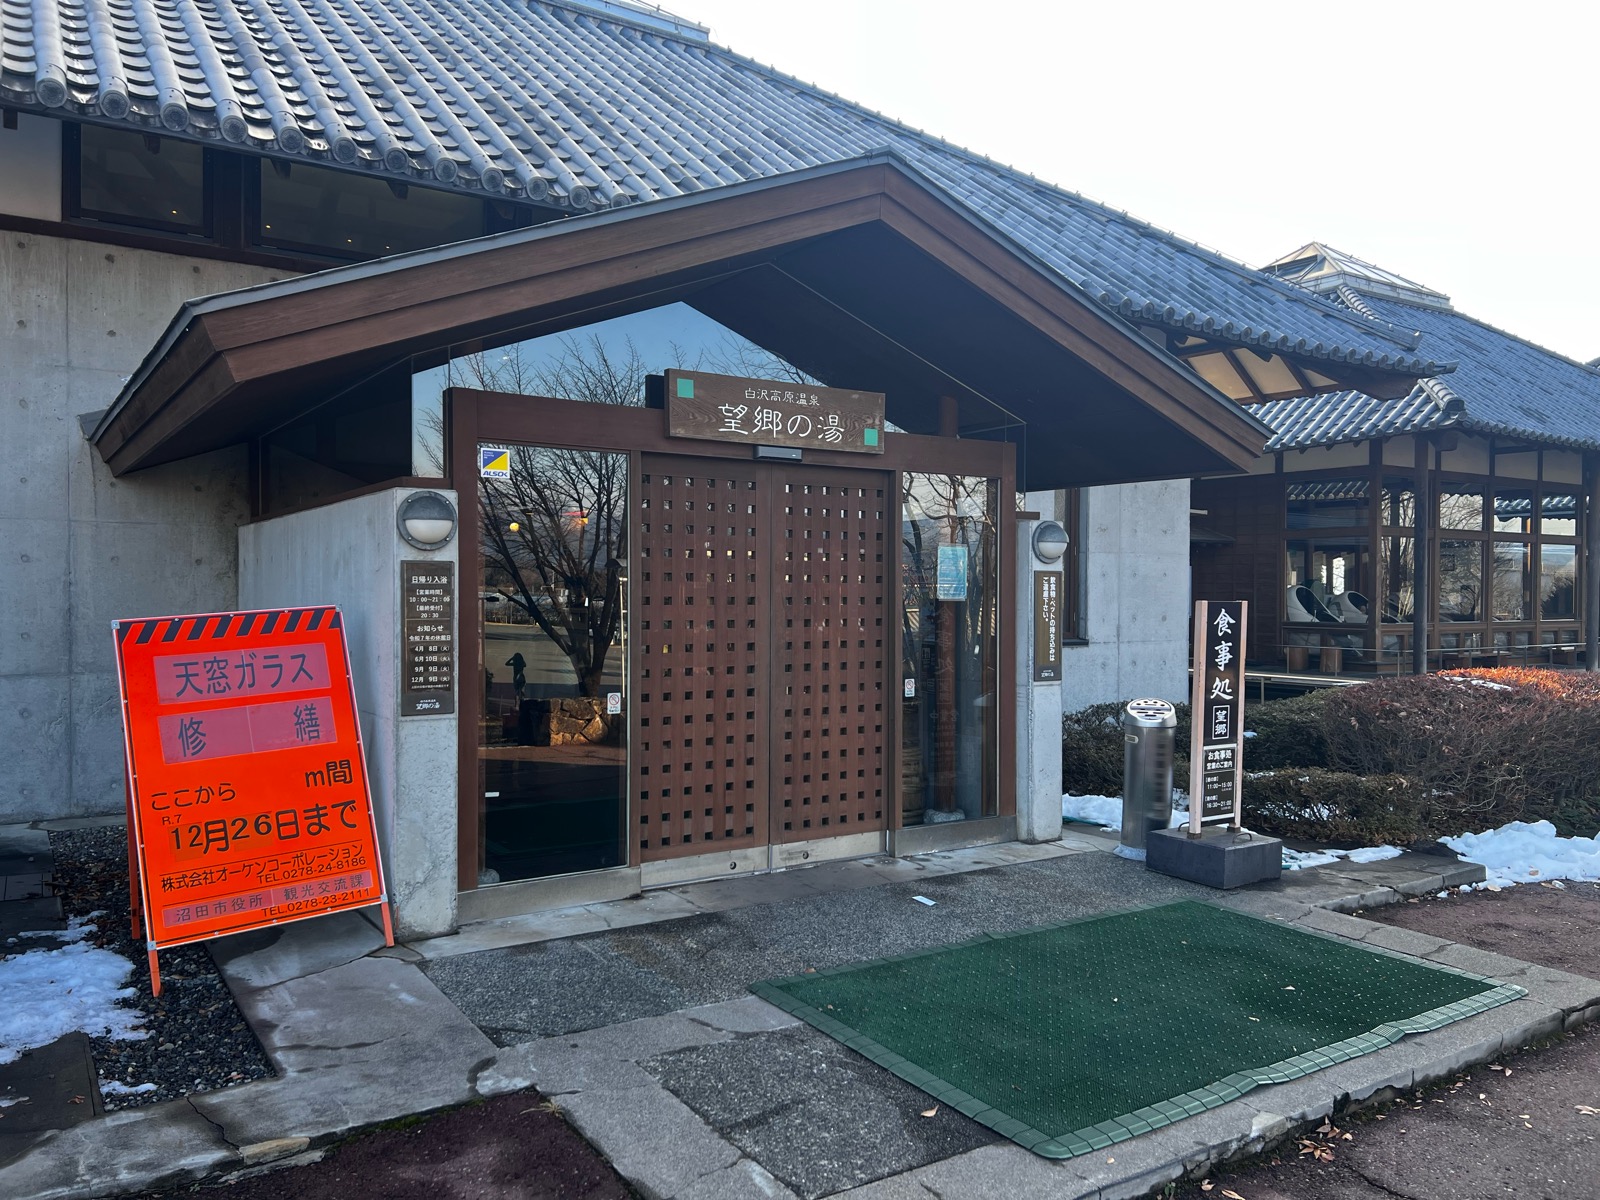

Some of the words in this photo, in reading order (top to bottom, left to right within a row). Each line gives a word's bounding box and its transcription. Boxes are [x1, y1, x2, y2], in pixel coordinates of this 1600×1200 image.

[744, 388, 820, 406] 白沢高原温泉
[717, 403, 844, 443] 望郷の湯
[411, 575, 448, 584] 日帰り入浴
[1210, 608, 1236, 700] 食事処
[172, 651, 314, 698] 天窓ガラス
[1215, 710, 1228, 736] 望郷
[1206, 760, 1233, 770] 営業のご案内
[1207, 750, 1232, 760] お食事処
[304, 759, 353, 788] m間
[151, 783, 236, 811] ここから
[161, 814, 182, 826] R.7
[170, 800, 358, 855] 12月26日まで
[161, 844, 364, 893] 株式会社オーケンコーポレーション
[256, 856, 366, 885] TEL.0278-24-8186
[176, 894, 263, 923] 沼田市役所
[283, 874, 364, 901] 観光交流課
[261, 887, 371, 918] TEL.0278-23-2111
